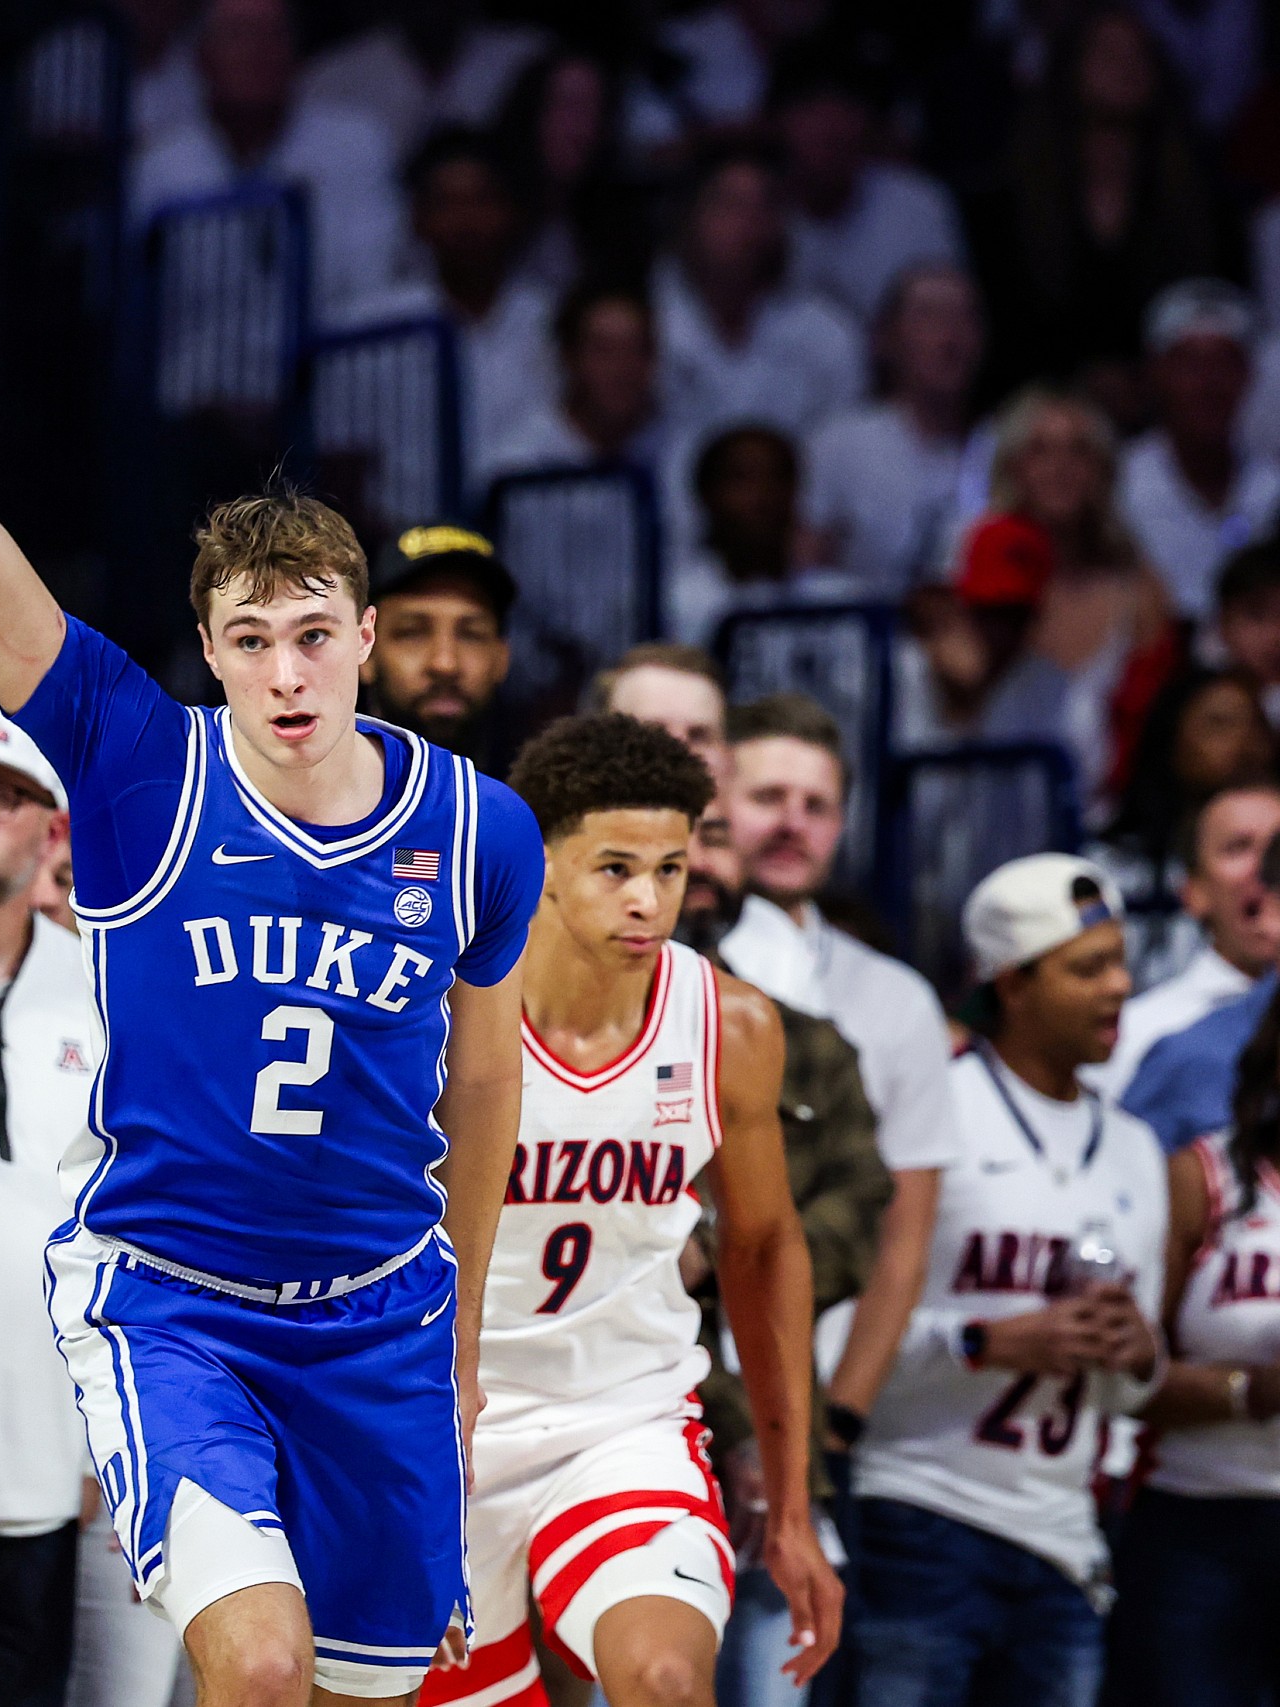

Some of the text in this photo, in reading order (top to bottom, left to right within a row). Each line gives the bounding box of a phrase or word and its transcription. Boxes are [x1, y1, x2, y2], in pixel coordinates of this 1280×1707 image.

[401, 900, 430, 911] ACC
[183, 915, 434, 1013] DUKE
[250, 1005, 335, 1135] 2
[535, 1222, 593, 1314] 9
